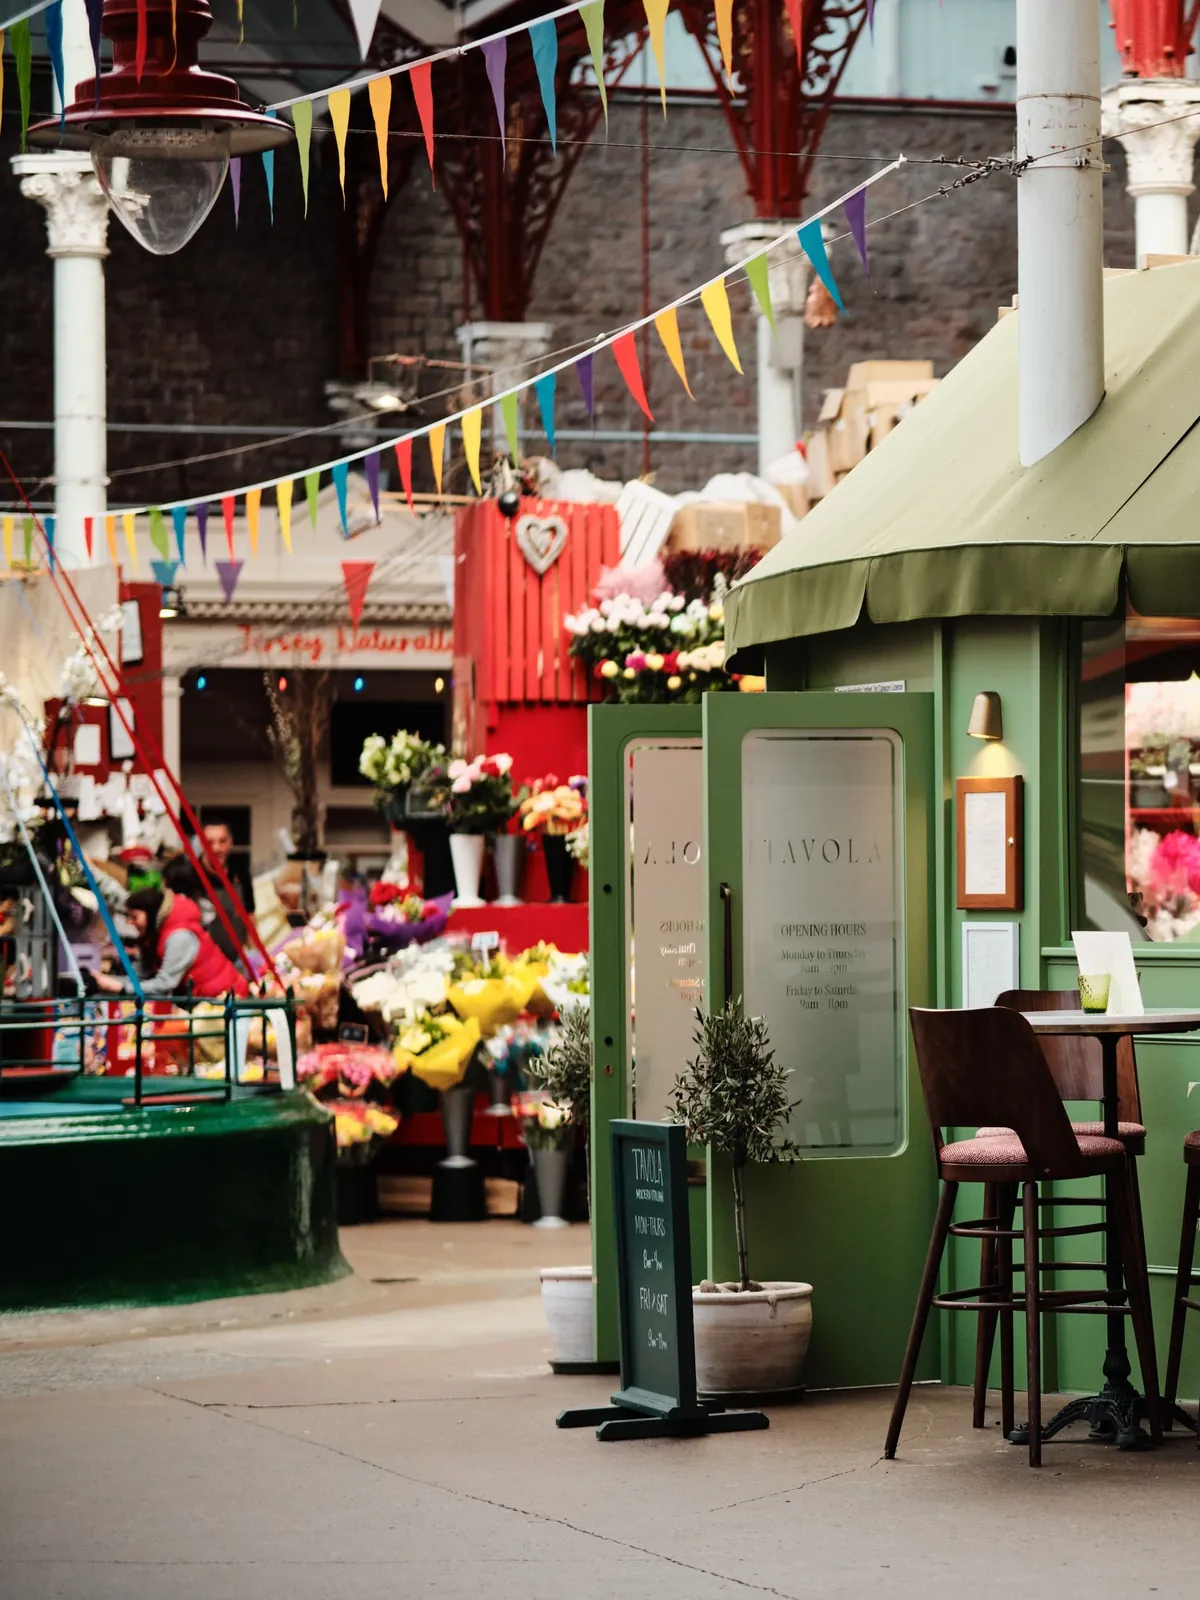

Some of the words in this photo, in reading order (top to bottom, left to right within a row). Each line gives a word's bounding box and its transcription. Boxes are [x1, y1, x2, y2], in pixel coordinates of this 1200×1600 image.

[763, 838, 882, 863] TAVOLA
[780, 923, 828, 937] OPENING
[830, 922, 867, 937] HOURS
[780, 949, 814, 961] Monday
[816, 949, 826, 960] to
[786, 985, 812, 998] Friday
[814, 985, 824, 996] to
[631, 1148, 664, 1187] TAVOLA
